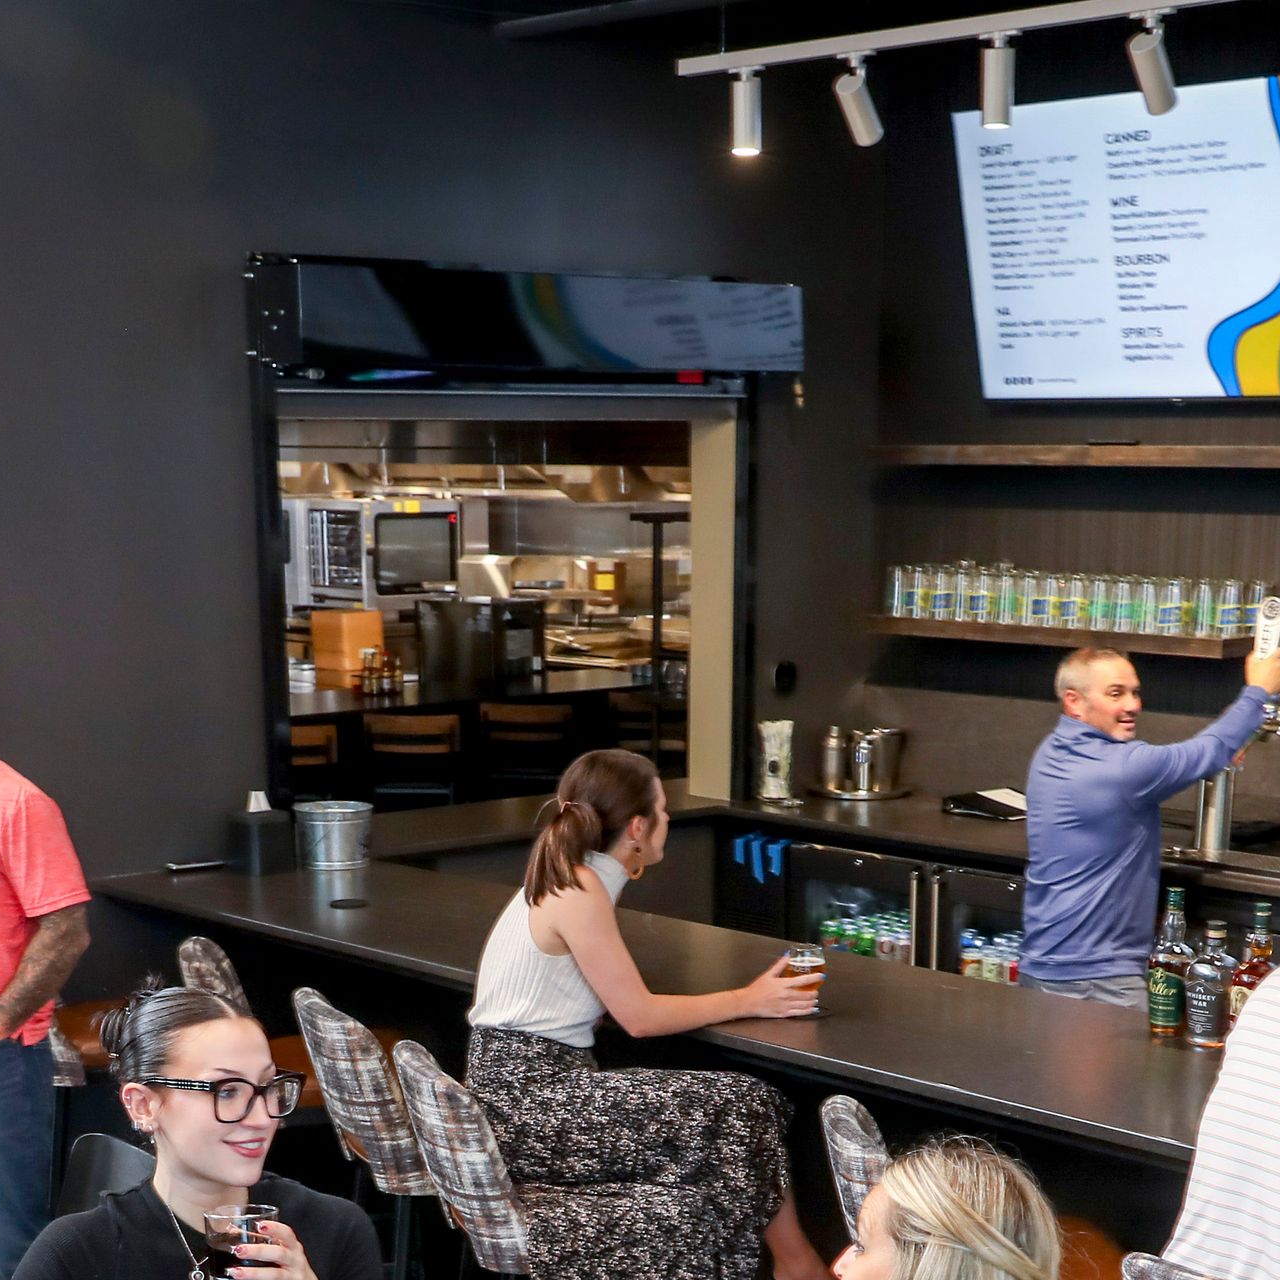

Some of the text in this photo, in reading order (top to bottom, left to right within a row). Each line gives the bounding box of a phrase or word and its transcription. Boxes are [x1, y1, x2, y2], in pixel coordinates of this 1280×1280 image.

[1104, 129, 1152, 145] CANNED
[978, 143, 1013, 157] DRAFT
[1110, 195, 1139, 207] WINE
[1114, 253, 1170, 267] BOURBON
[1121, 326, 1164, 339] SPIRITS
[1186, 991, 1217, 1001] WHISKEY
[1192, 1000, 1208, 1008] WAR
